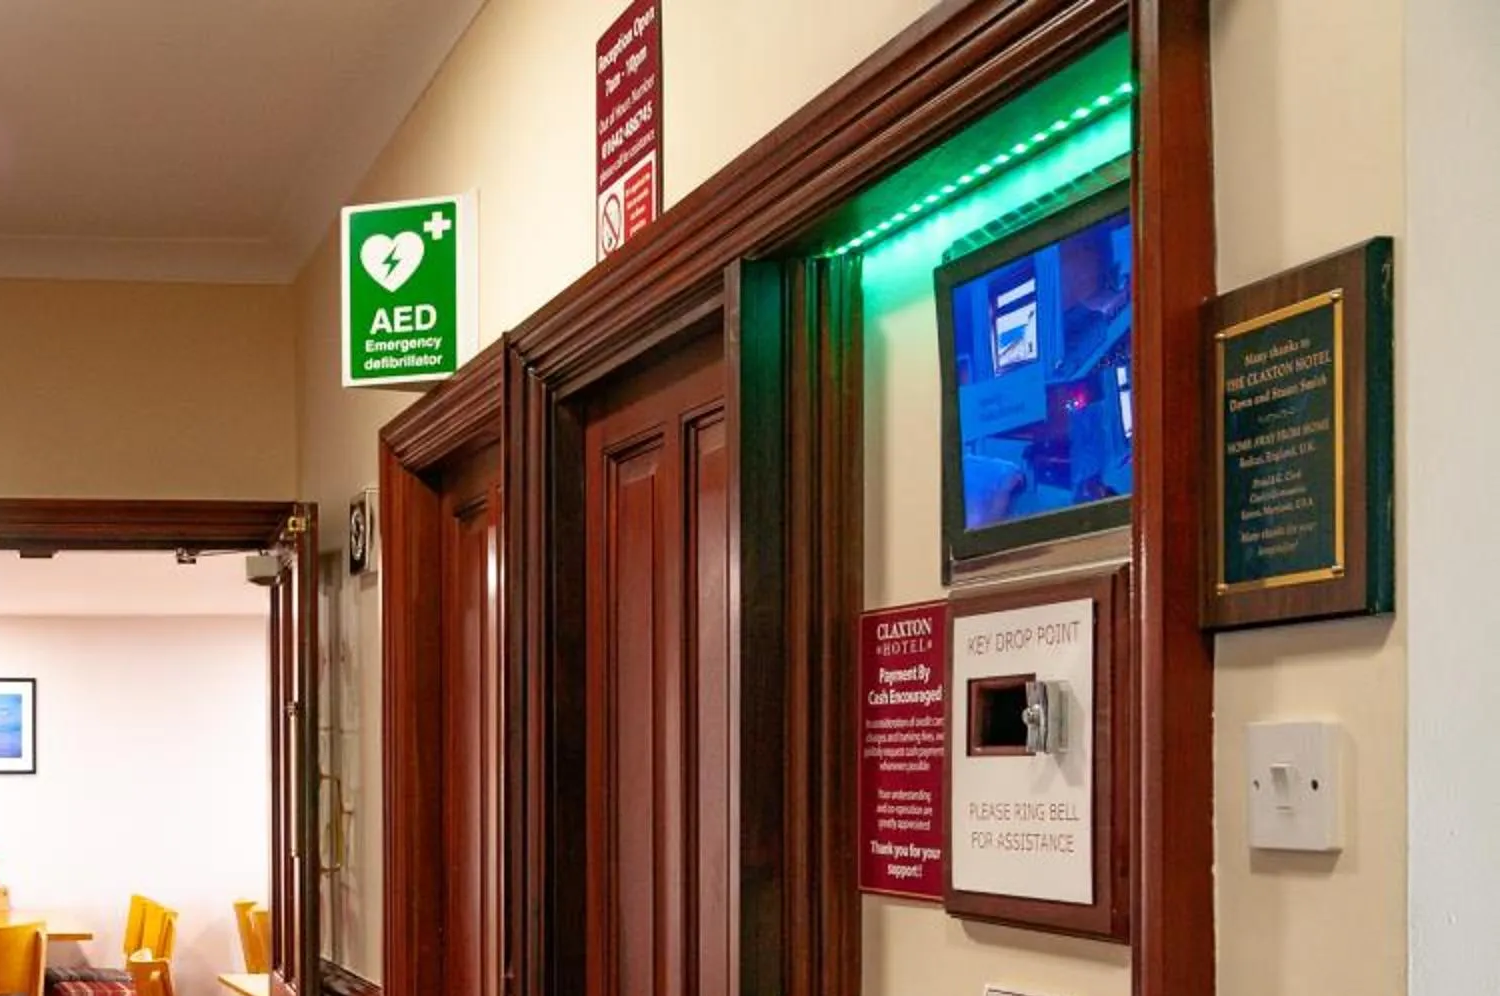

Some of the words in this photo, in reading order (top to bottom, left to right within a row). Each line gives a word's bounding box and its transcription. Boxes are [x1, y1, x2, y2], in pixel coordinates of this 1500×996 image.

[633, 6, 655, 37] Open
[370, 304, 437, 334] AED
[366, 336, 442, 352] Emergency
[364, 354, 443, 370] defibrillator
[1247, 359, 1295, 386] CLAXTON
[1296, 349, 1332, 373] HOTEL
[877, 617, 933, 641] CLAXTON
[967, 635, 991, 655] KEY
[995, 628, 1032, 653] DROP
[1038, 620, 1081, 646] POINT
[883, 637, 927, 656] HOTEL
[879, 666, 917, 686] Payment
[918, 663, 931, 684] By
[867, 688, 889, 705] Cash
[889, 684, 943, 706] Encouraged
[969, 802, 1011, 821] PLEASE
[1014, 802, 1046, 821] RING
[1049, 802, 1081, 822] BELL
[870, 840, 893, 855] Thank
[894, 845, 908, 860] you
[909, 842, 920, 858] for
[921, 848, 941, 862] your
[971, 831, 994, 850] FOR
[996, 831, 1076, 853] ASSISTANCE
